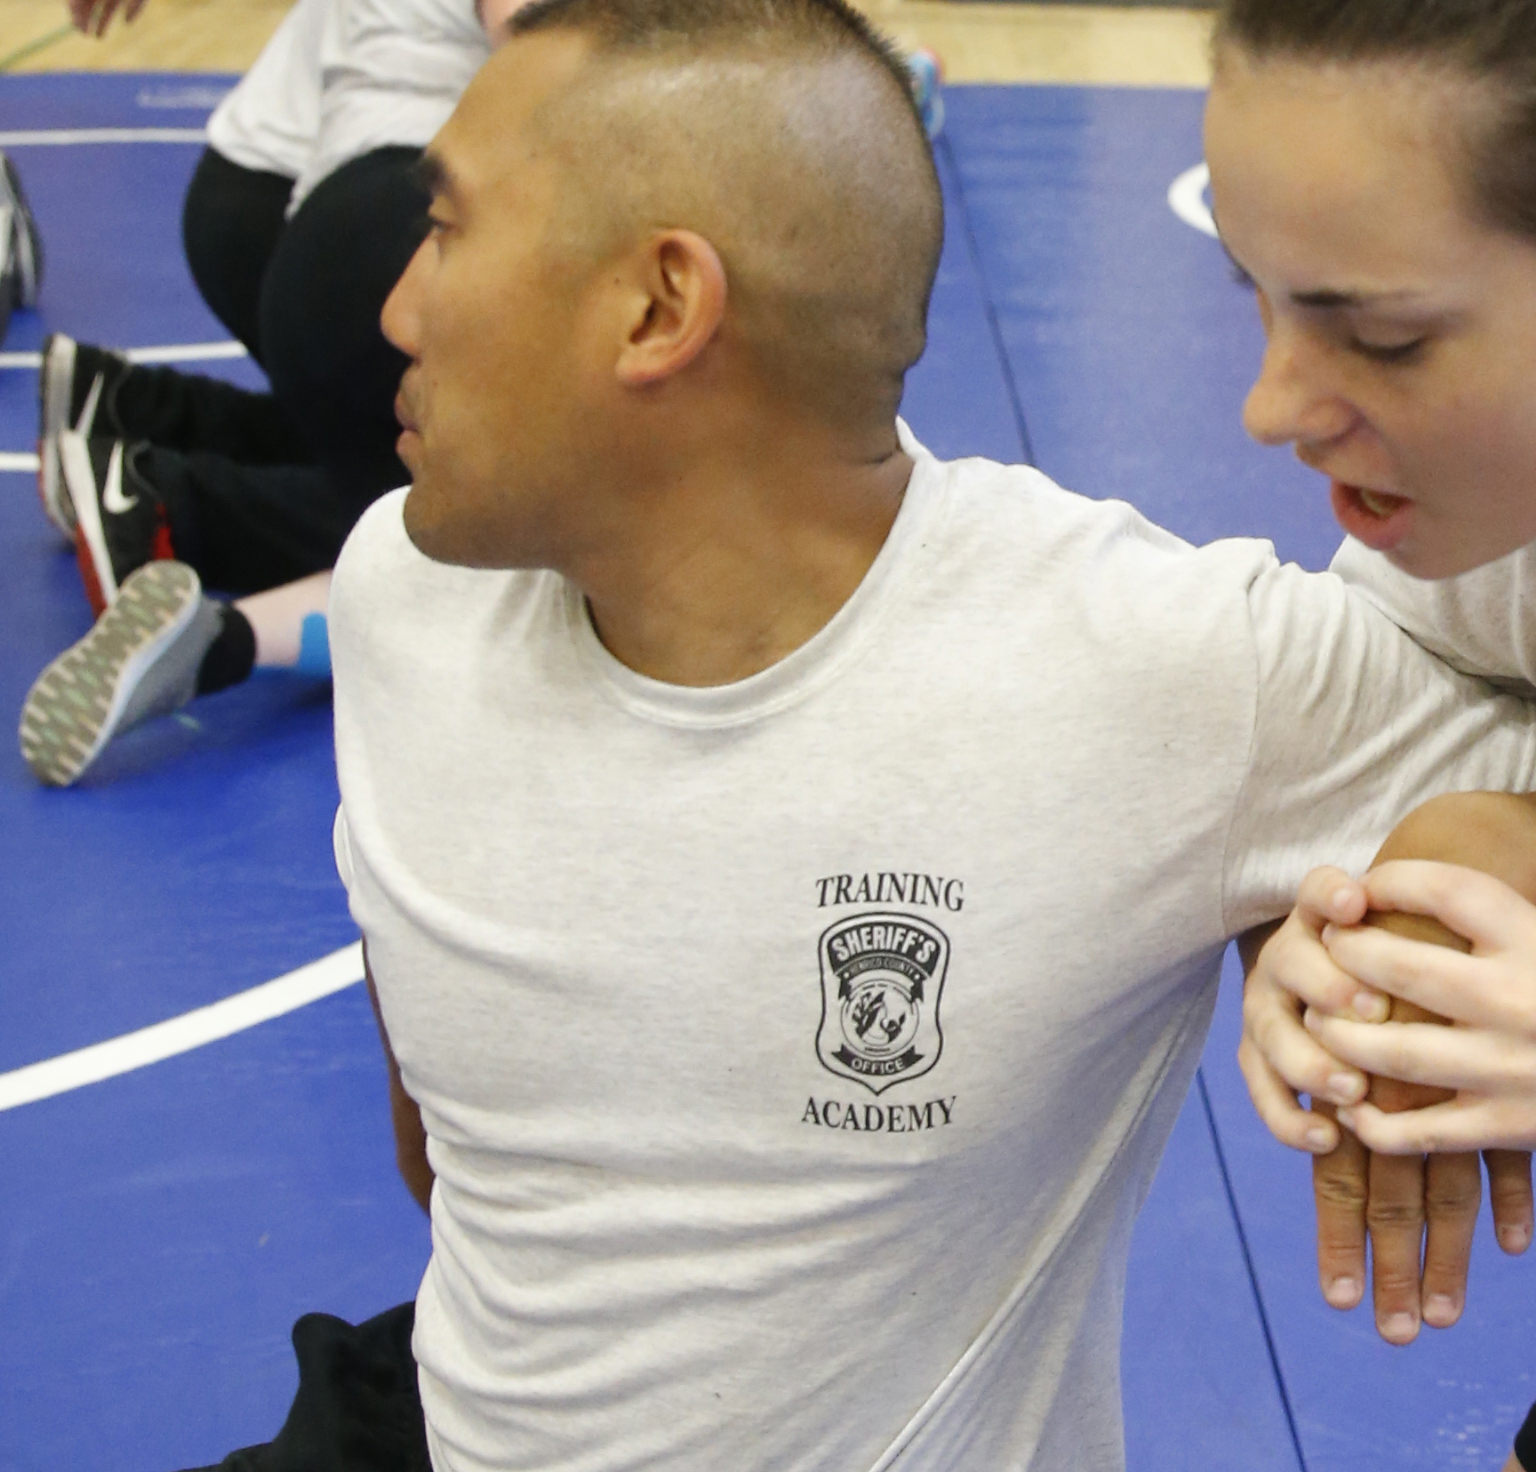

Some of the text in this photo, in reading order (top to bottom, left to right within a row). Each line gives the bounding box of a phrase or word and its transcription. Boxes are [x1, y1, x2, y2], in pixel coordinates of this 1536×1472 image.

[815, 873, 965, 912] TRAINING
[832, 926, 936, 963] SHERIFF'S
[852, 1057, 904, 1075] OFFICE
[801, 1096, 957, 1133] ACADEMY
